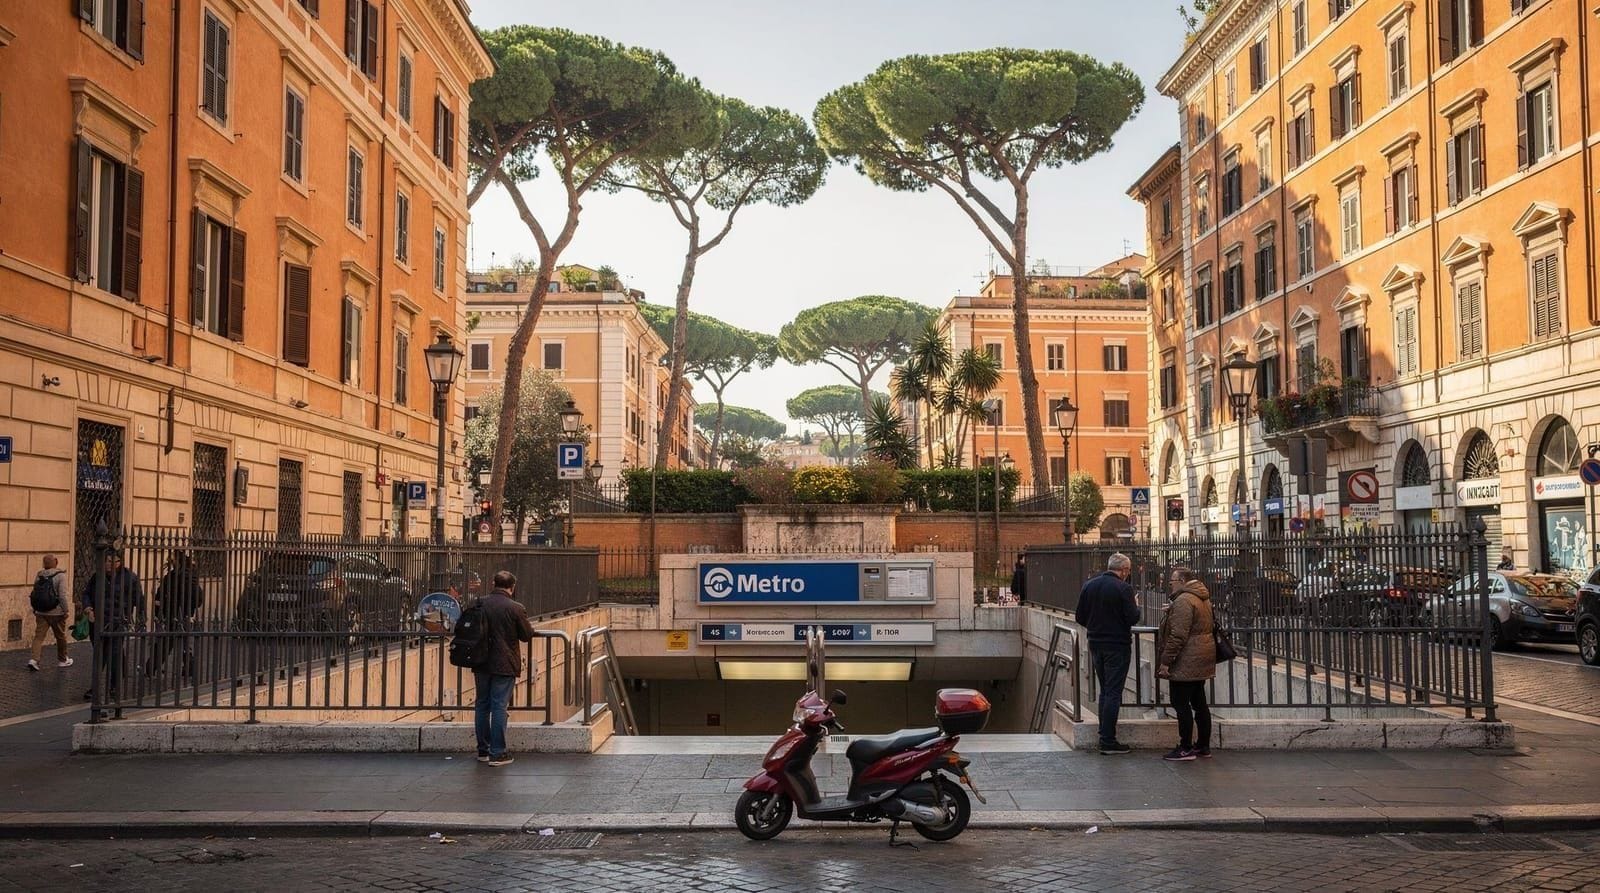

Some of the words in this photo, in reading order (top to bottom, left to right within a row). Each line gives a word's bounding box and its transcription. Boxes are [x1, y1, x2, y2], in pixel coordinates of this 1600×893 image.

[565, 448, 578, 464] P
[412, 485, 422, 497] P
[737, 574, 805, 593] Metro
